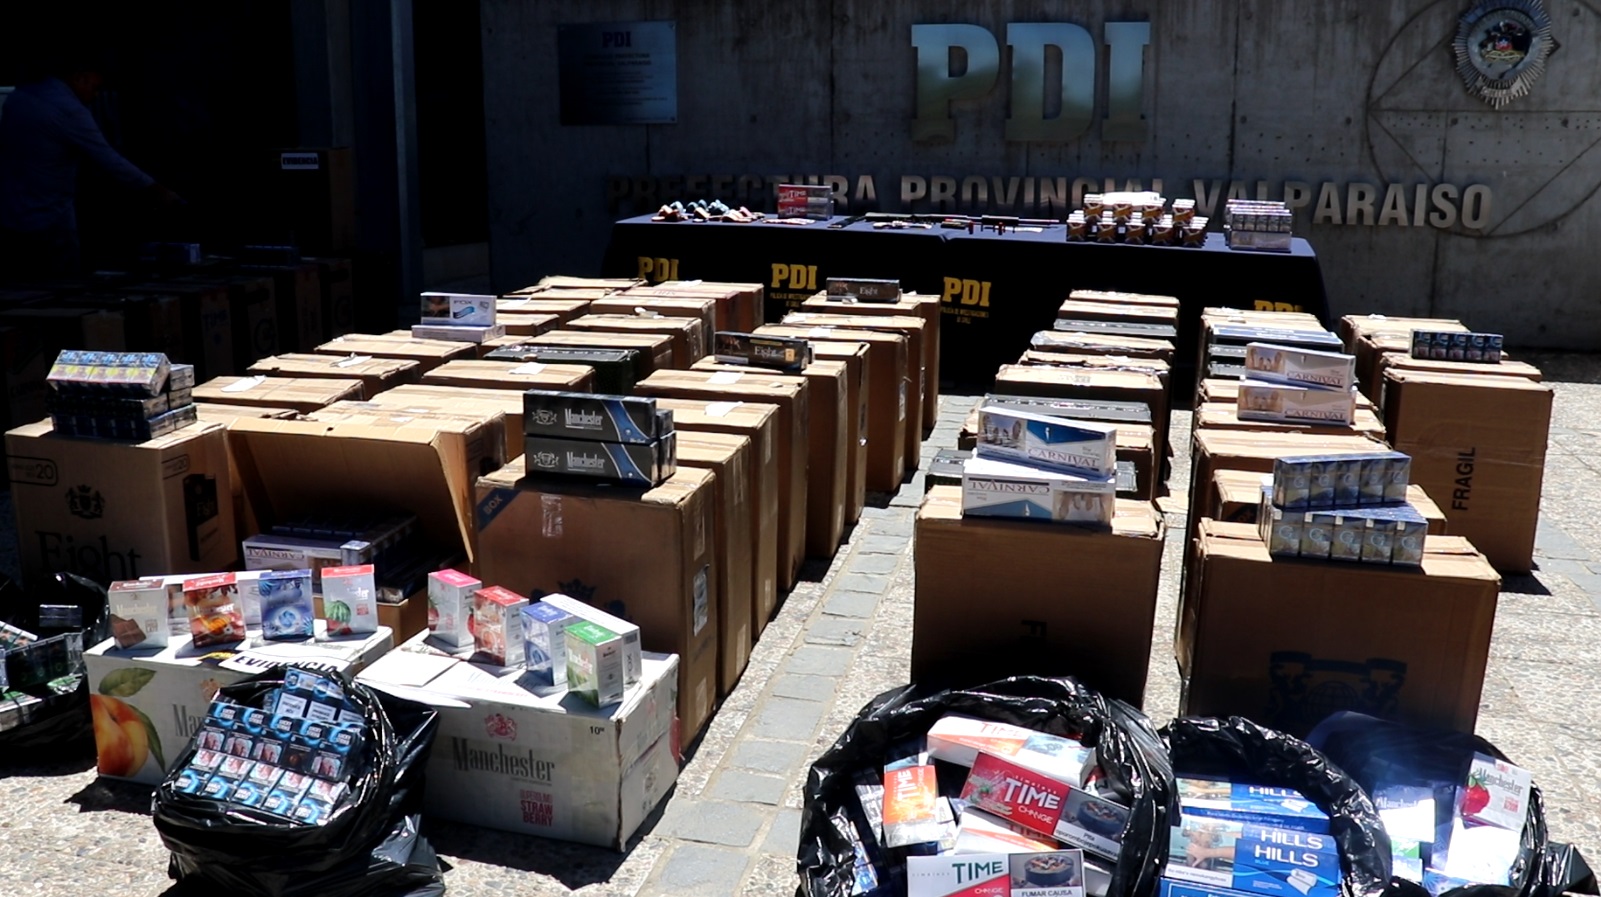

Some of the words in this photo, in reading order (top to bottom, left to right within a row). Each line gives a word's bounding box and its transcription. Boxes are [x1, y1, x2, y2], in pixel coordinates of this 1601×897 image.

[602, 31, 631, 48] PDI
[910, 22, 1151, 144] PDI
[609, 174, 878, 214] PREFECTRA
[900, 175, 1164, 216] PROVINC
[637, 256, 680, 281] PDI
[770, 263, 818, 290] PDI
[859, 286, 879, 297] Eight
[943, 276, 992, 307] PDI
[1286, 371, 1344, 385] CARNIVAL
[564, 408, 604, 427] Manchester
[1284, 409, 1346, 421] CARNIVAL
[566, 451, 605, 469] Manchester
[1027, 448, 1101, 468] CARNIVAL
[36, 464, 54, 480] 20
[1451, 447, 1476, 511] FRAGIL
[971, 480, 1051, 494] CARNIVAL
[482, 494, 504, 516] BOX
[35, 531, 141, 580] Eight
[451, 736, 556, 782] Manchester
[897, 769, 920, 801] TIME
[1477, 767, 1524, 794] Manchester
[1003, 777, 1061, 809] TIME
[520, 800, 553, 815] STRAW
[1018, 805, 1053, 824] CHANGE
[523, 812, 553, 827] BERRY
[1260, 829, 1324, 850] HILLS
[1254, 844, 1320, 868] HILLS
[951, 861, 1004, 884] TIME
